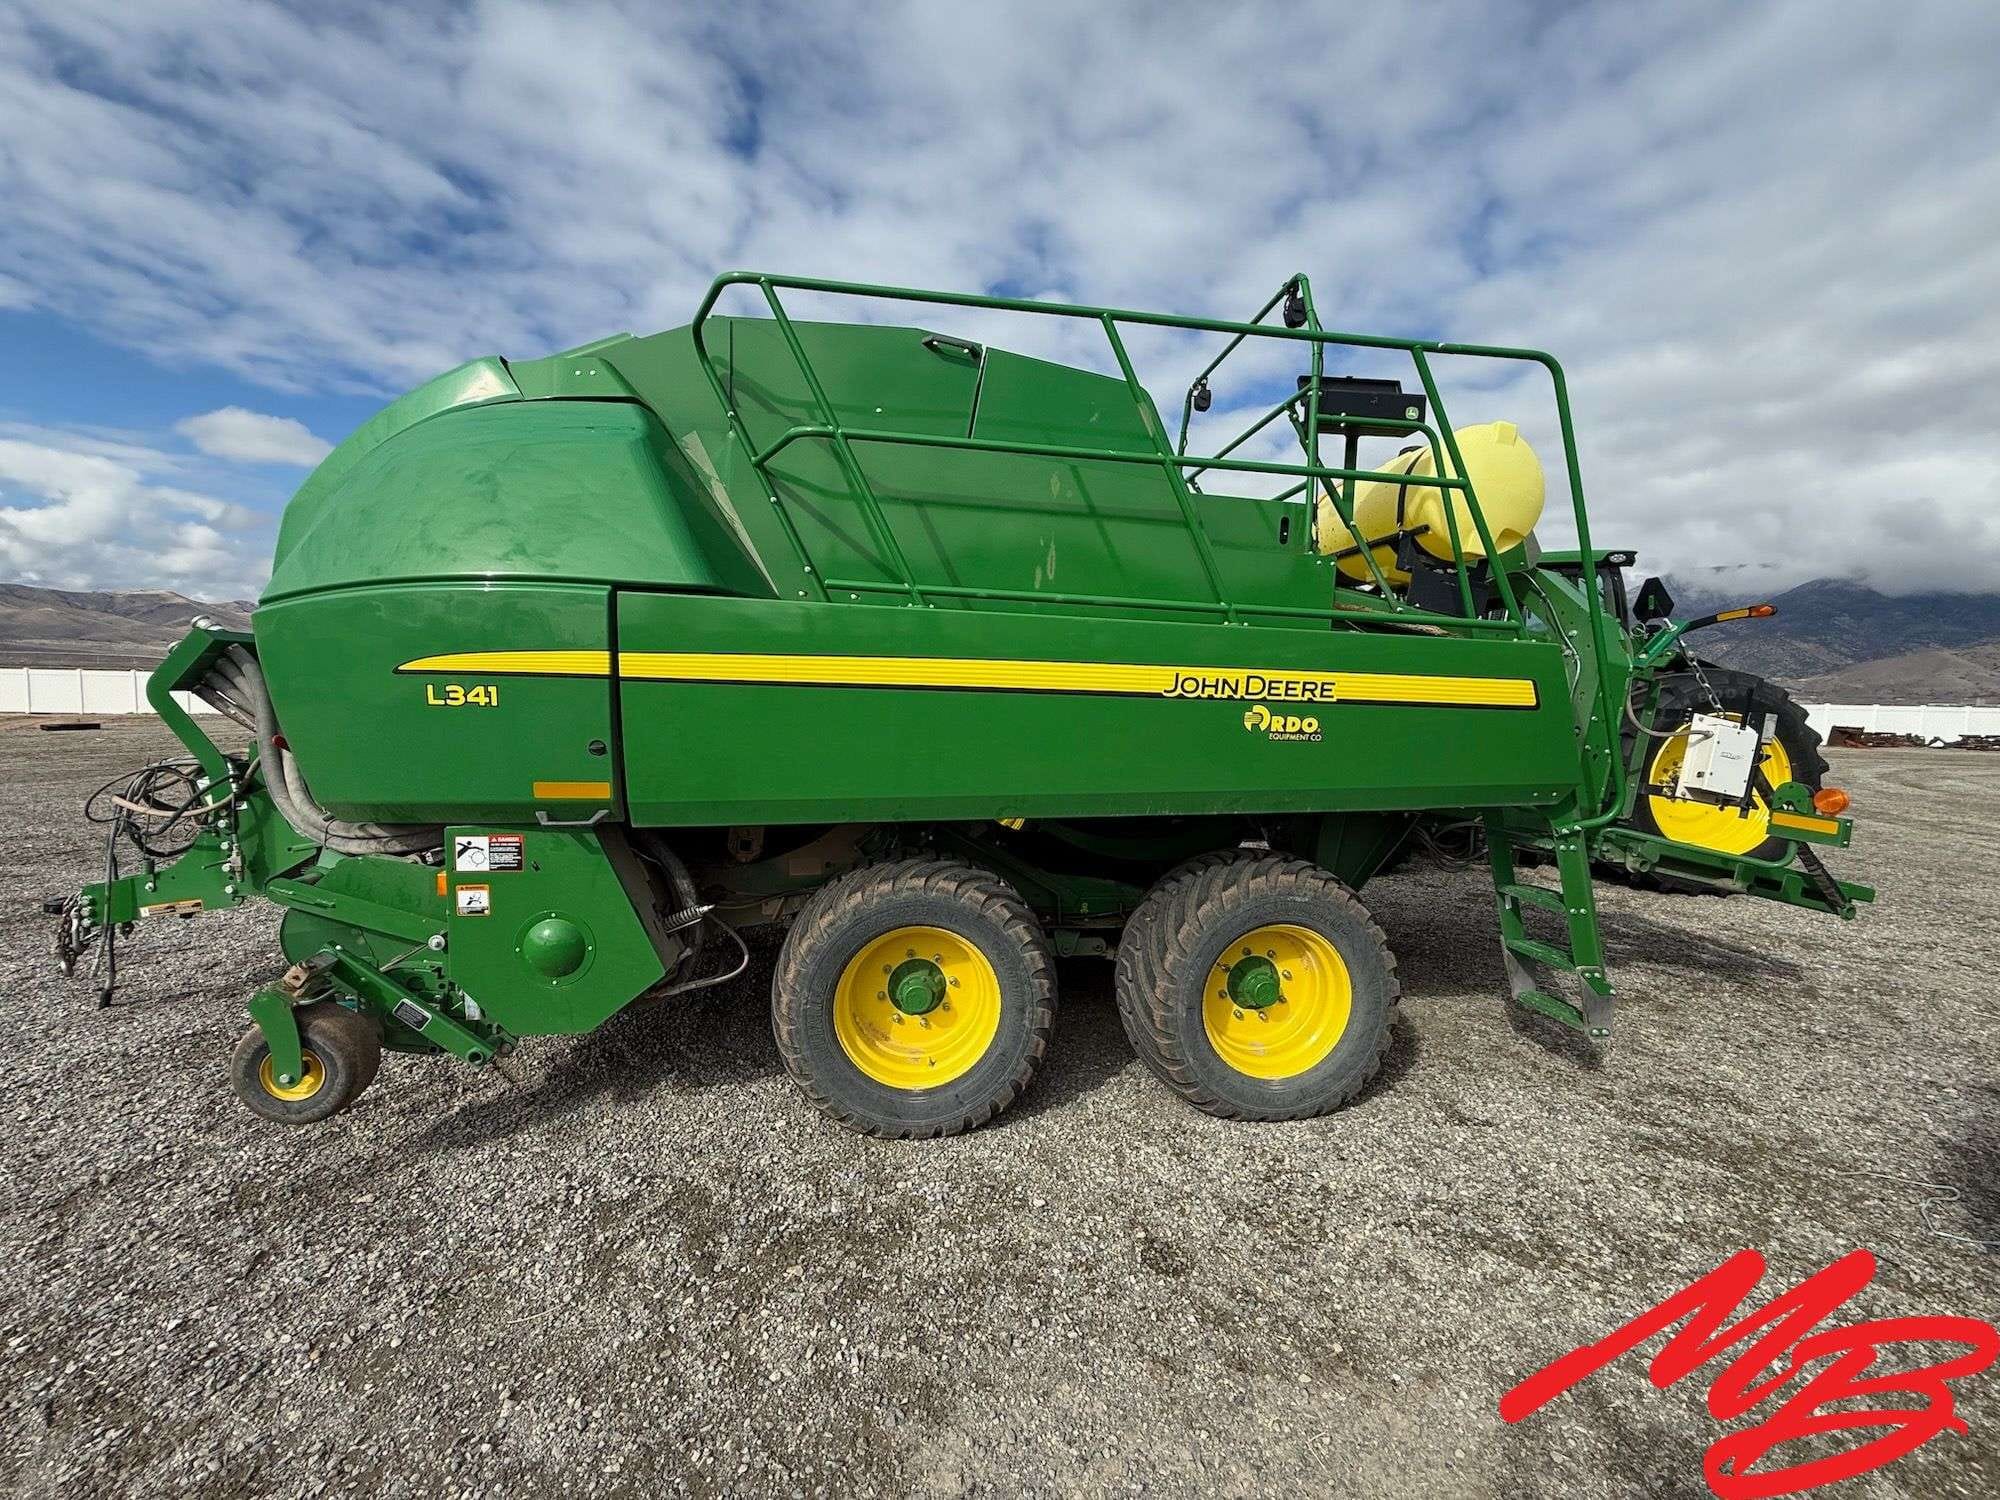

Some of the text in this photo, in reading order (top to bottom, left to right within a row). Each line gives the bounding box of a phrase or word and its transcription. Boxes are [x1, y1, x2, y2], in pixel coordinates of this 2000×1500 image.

[426, 684, 499, 707] L341
[1163, 672, 1336, 698] JOHN DEERE
[1269, 732, 1309, 741] EQUIPMENT
